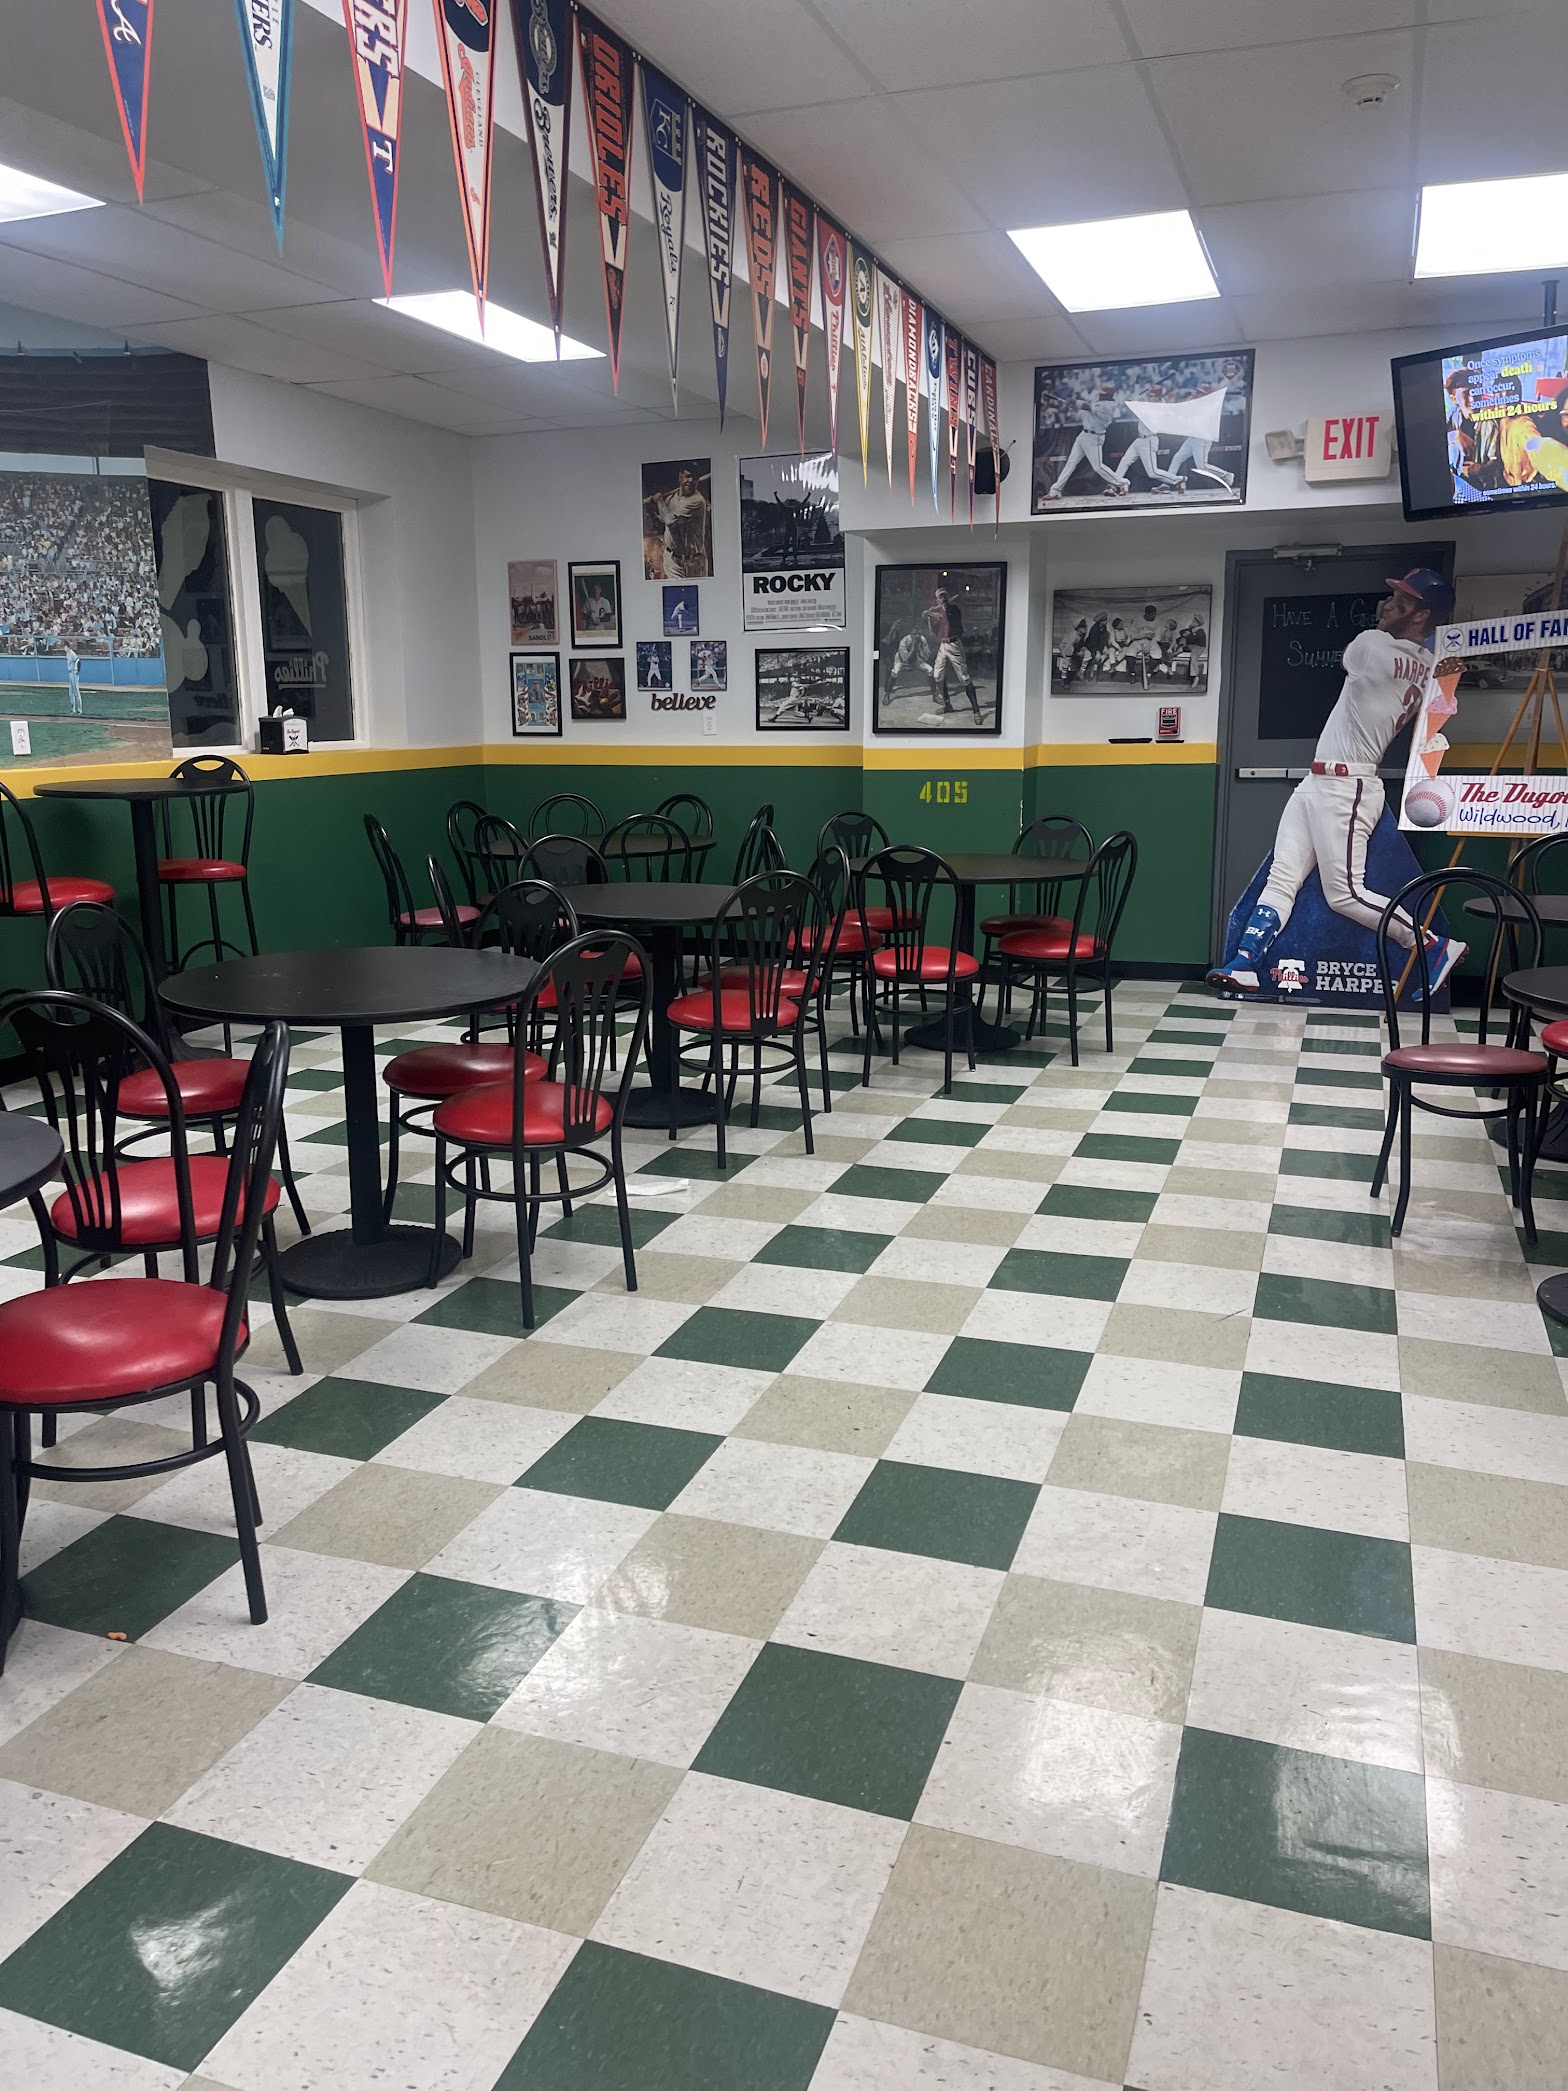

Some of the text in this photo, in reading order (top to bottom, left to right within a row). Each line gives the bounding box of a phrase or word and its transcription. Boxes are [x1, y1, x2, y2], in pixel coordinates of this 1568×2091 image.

[251, 0, 273, 50] ERS
[458, 43, 476, 150] Indians
[475, 71, 484, 148] CLEVELAND
[592, 33, 627, 227] ORIOLES
[655, 106, 671, 149] KC
[372, 140, 394, 174] T
[706, 126, 730, 290] ROCKIES
[660, 191, 678, 274] Royals
[751, 163, 774, 301] REDS
[790, 197, 810, 335] GIANTS
[908, 298, 918, 423] DIAMONDBACKS
[1467, 350, 1540, 370] Once symptoms
[1468, 361, 1532, 386] appear death
[948, 338, 959, 429] TWINS
[967, 349, 977, 427] CUBS
[1469, 381, 1515, 397] can occur,
[985, 363, 999, 453] CARDINALS
[1470, 394, 1520, 409] sometimes
[1471, 400, 1558, 422] within 24 hours
[1322, 416, 1380, 461] EXIT
[753, 572, 836, 594] ROCKY
[1326, 601, 1338, 628] A
[1350, 598, 1379, 628] GRE
[1468, 625, 1508, 647] HALL
[1513, 621, 1535, 641] OF
[1394, 657, 1431, 689] HARPE
[651, 692, 717, 711] believe
[919, 781, 968, 804] 405
[1460, 782, 1499, 803] The
[1459, 807, 1561, 830] Wildwood,
[1269, 966, 1309, 984] Phillies
[1316, 960, 1377, 977] BRYCE
